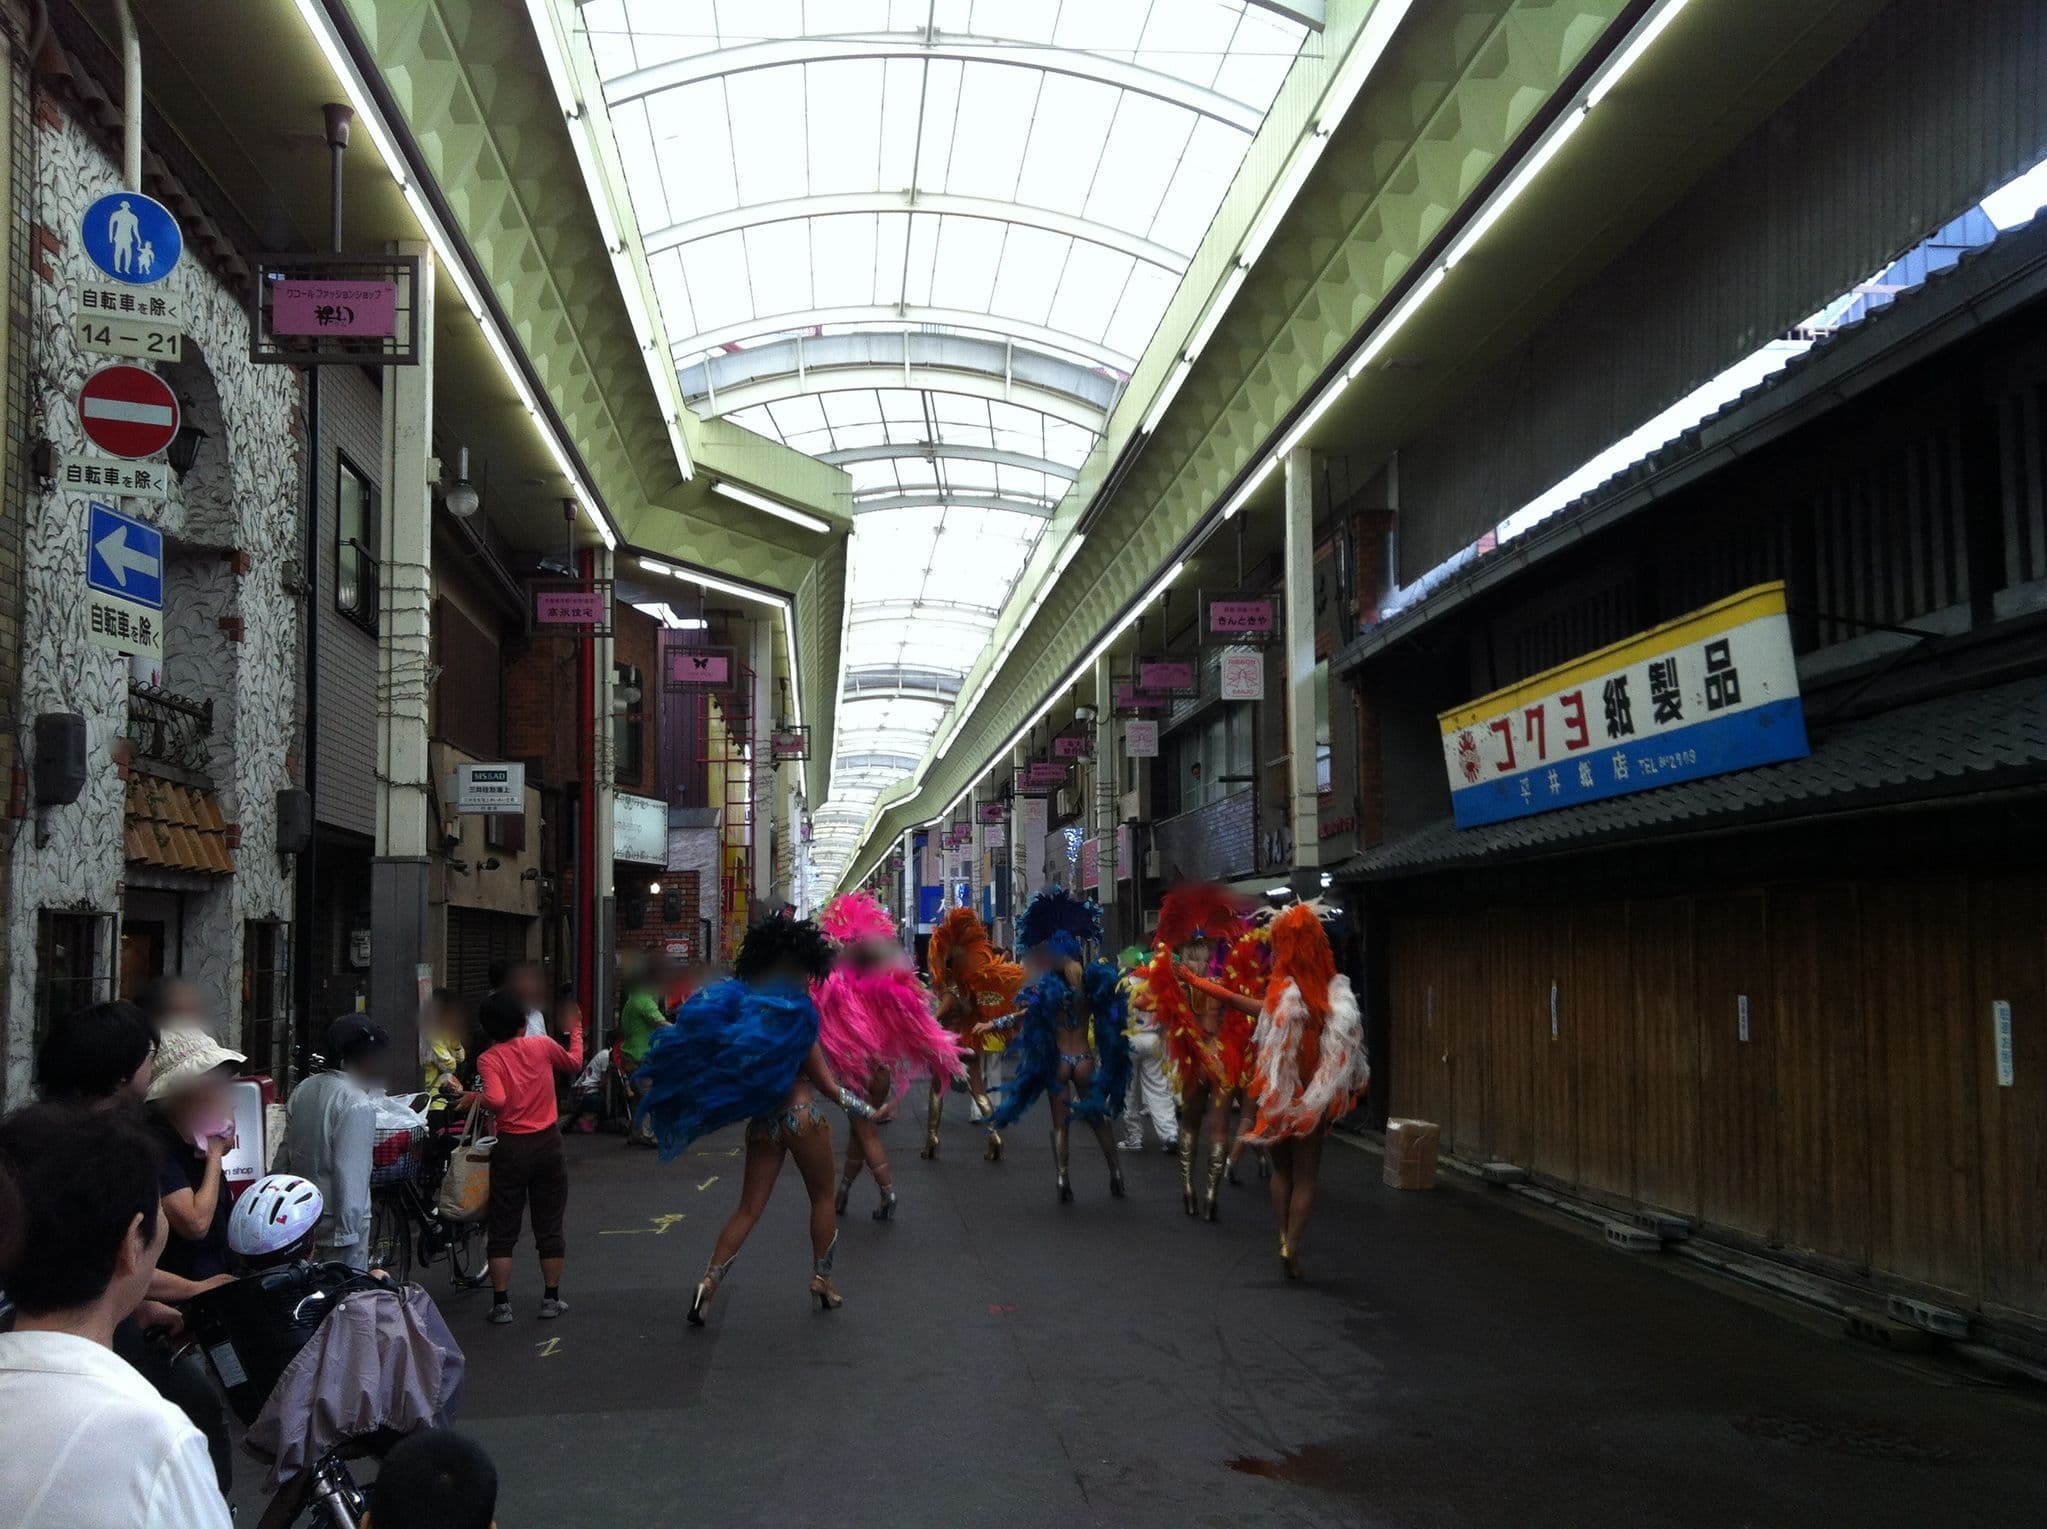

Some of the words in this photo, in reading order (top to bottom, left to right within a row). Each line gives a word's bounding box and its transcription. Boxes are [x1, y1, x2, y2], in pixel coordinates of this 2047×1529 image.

[82, 288, 178, 318] 自転車を除く
[66, 464, 163, 492] 自転車を除く
[91, 602, 159, 650] 自転車を除く
[1218, 616, 1267, 626] きんときや
[474, 772, 506, 781] MS&AD
